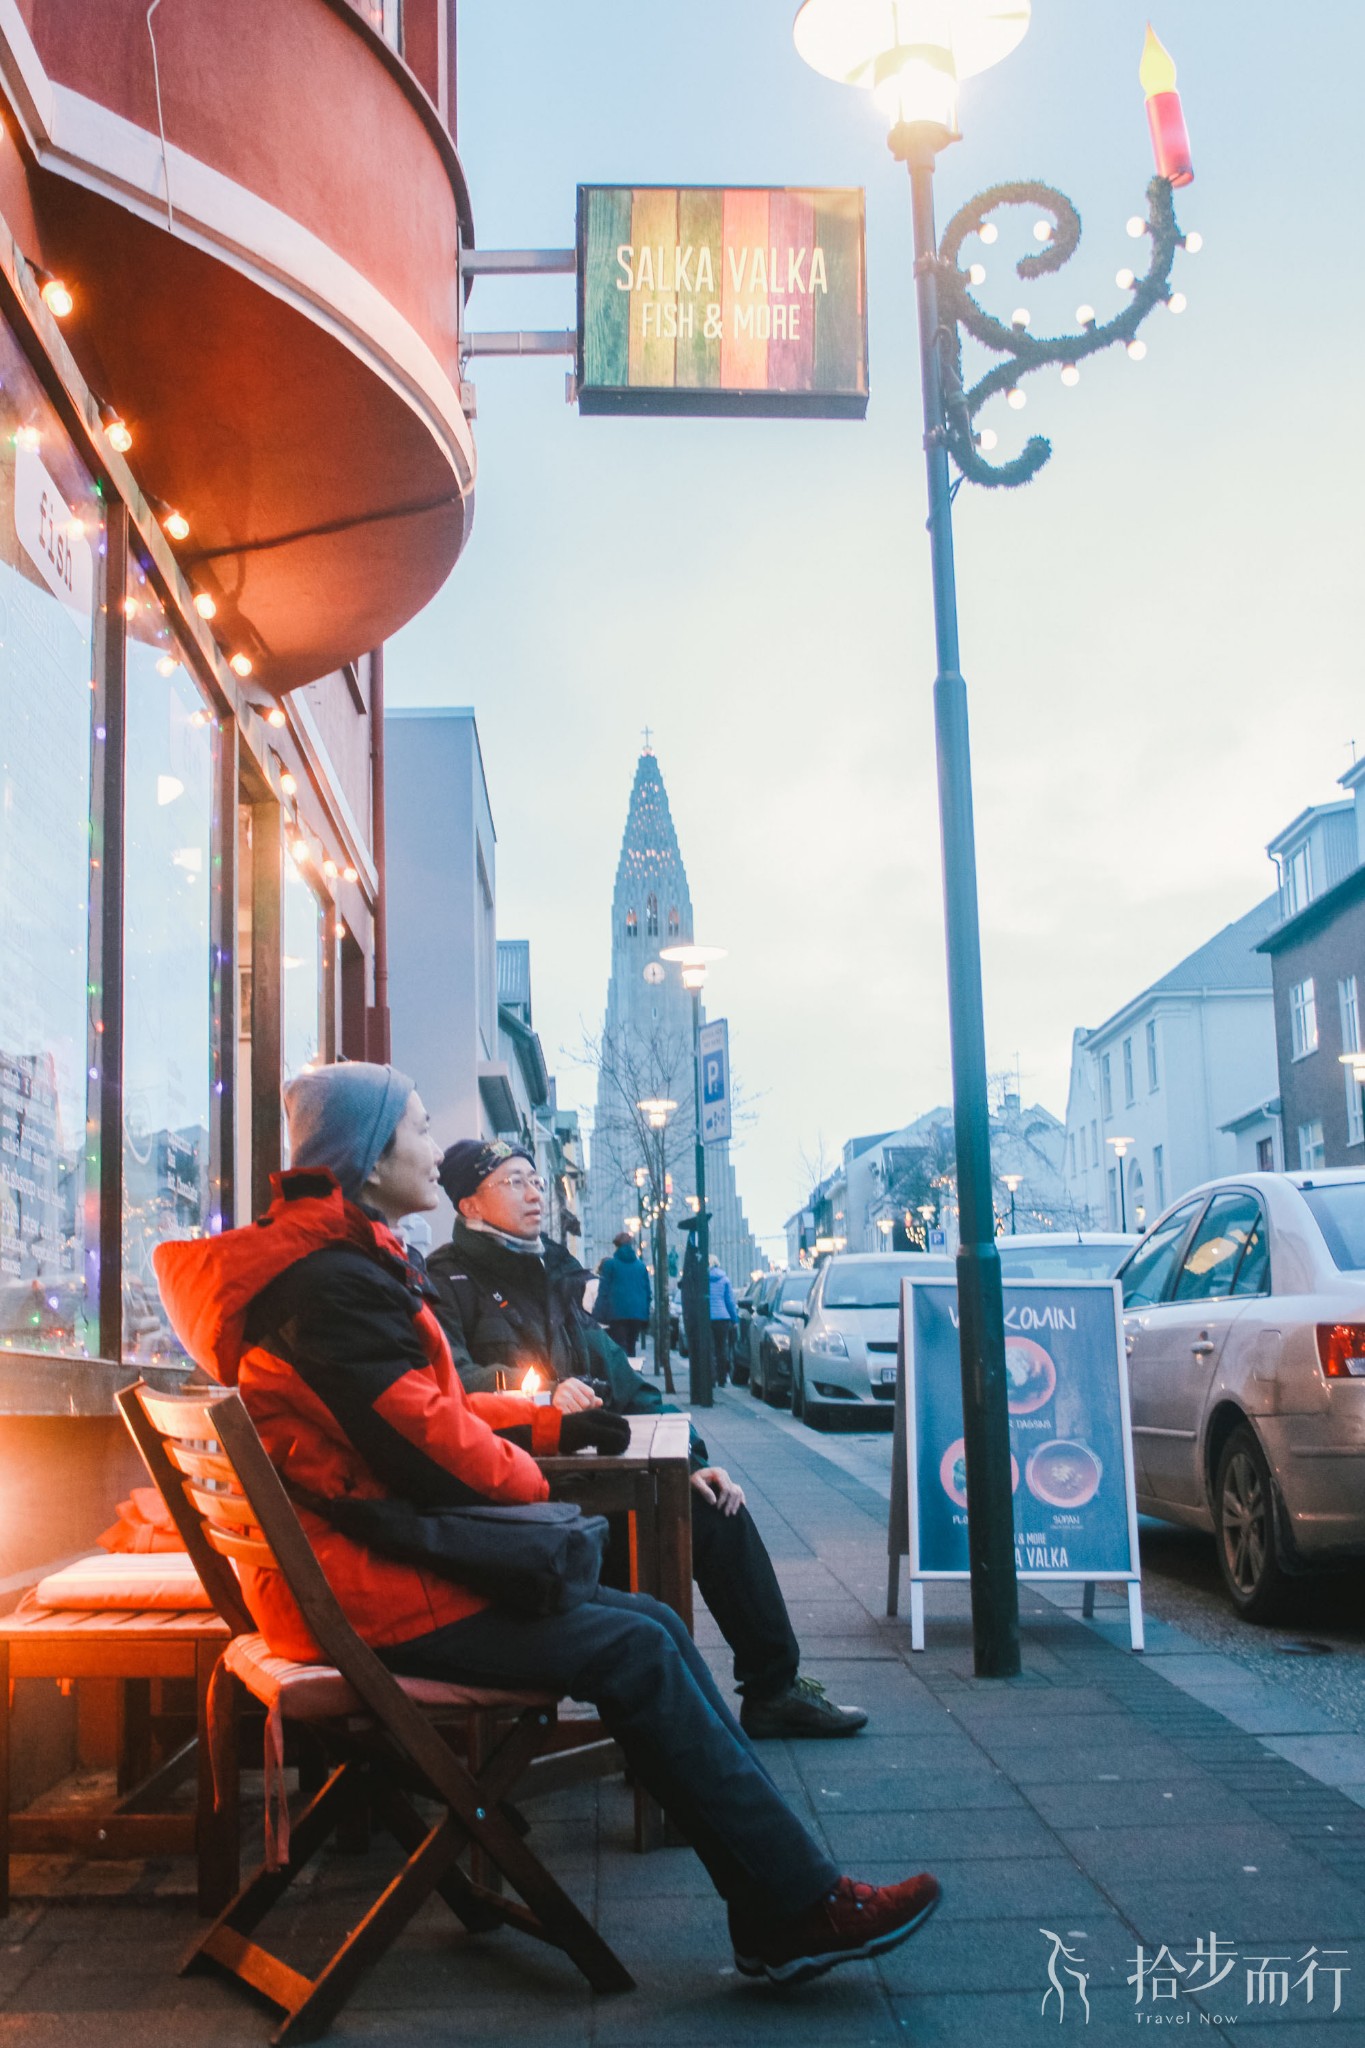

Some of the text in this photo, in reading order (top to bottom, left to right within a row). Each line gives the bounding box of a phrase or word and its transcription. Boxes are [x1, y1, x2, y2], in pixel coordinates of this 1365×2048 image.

[616, 245, 828, 294] SALKA VALKA
[642, 302, 800, 341] FISH & MORE
[39, 489, 72, 593] fish
[707, 1060, 719, 1096] P
[1027, 1533, 1046, 1545] MORE
[1026, 1547, 1069, 1569] VALKA
